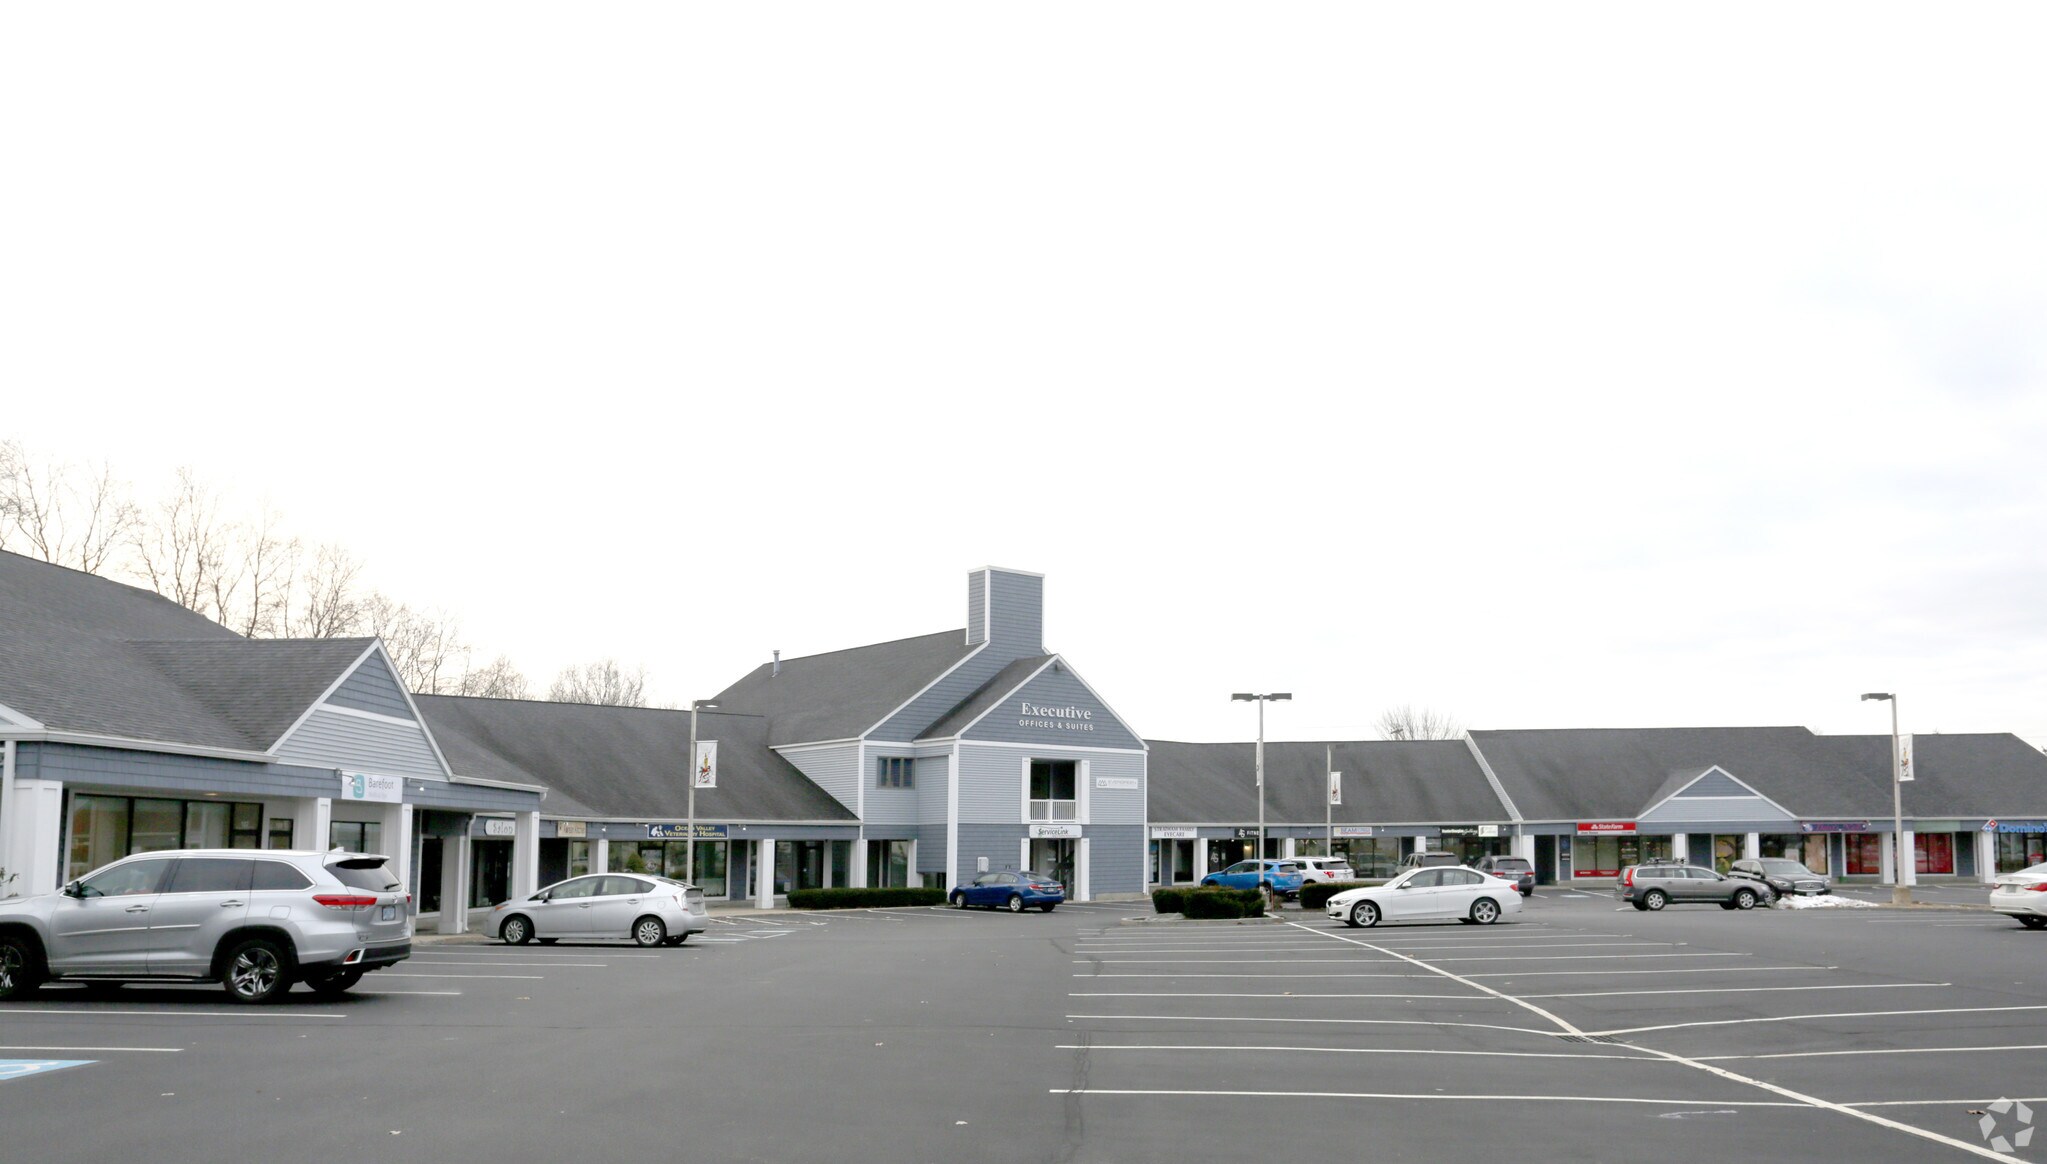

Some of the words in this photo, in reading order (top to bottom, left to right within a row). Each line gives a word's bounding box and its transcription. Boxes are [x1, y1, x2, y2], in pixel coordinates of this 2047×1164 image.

[1021, 702, 1092, 720] Executive
[1019, 719, 1054, 729] OFFICES
[1065, 722, 1094, 731] SUITES
[368, 777, 394, 790] Barefoot
[1998, 822, 2047, 833] Domino'
